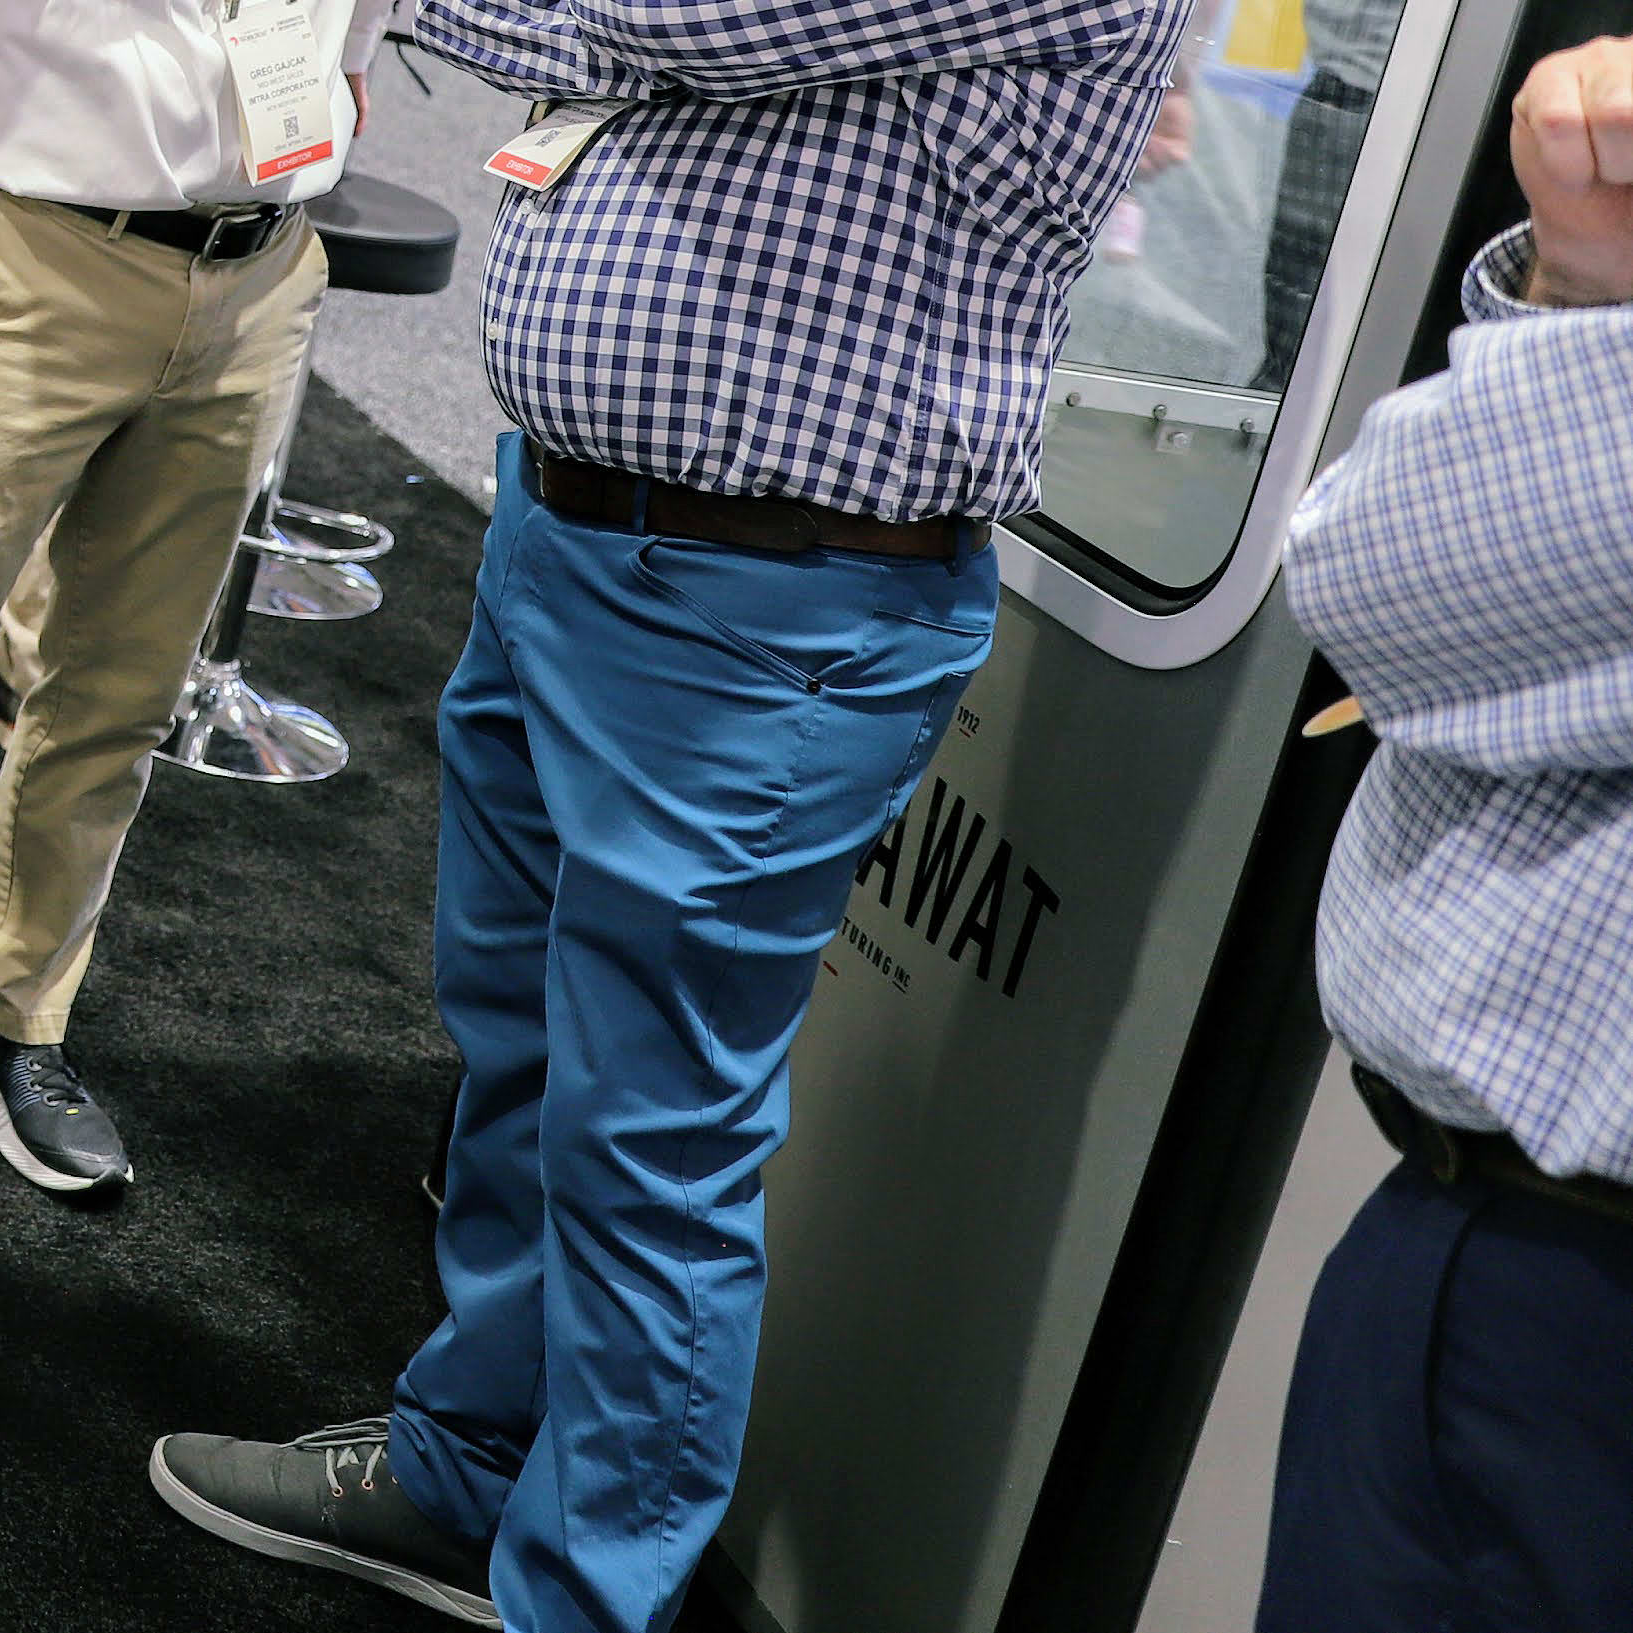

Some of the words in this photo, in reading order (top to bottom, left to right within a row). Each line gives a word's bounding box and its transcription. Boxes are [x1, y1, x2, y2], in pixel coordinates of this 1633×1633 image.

[250, 64, 274, 80] GREG
[249, 91, 270, 106] IMTRA
[271, 77, 319, 99] CORPORATION
[276, 151, 313, 169] EXHIBITOR
[957, 705, 981, 735] 1912
[854, 775, 1061, 999] AWAT
[840, 916, 892, 976] TURING
[893, 964, 912, 989] INC
